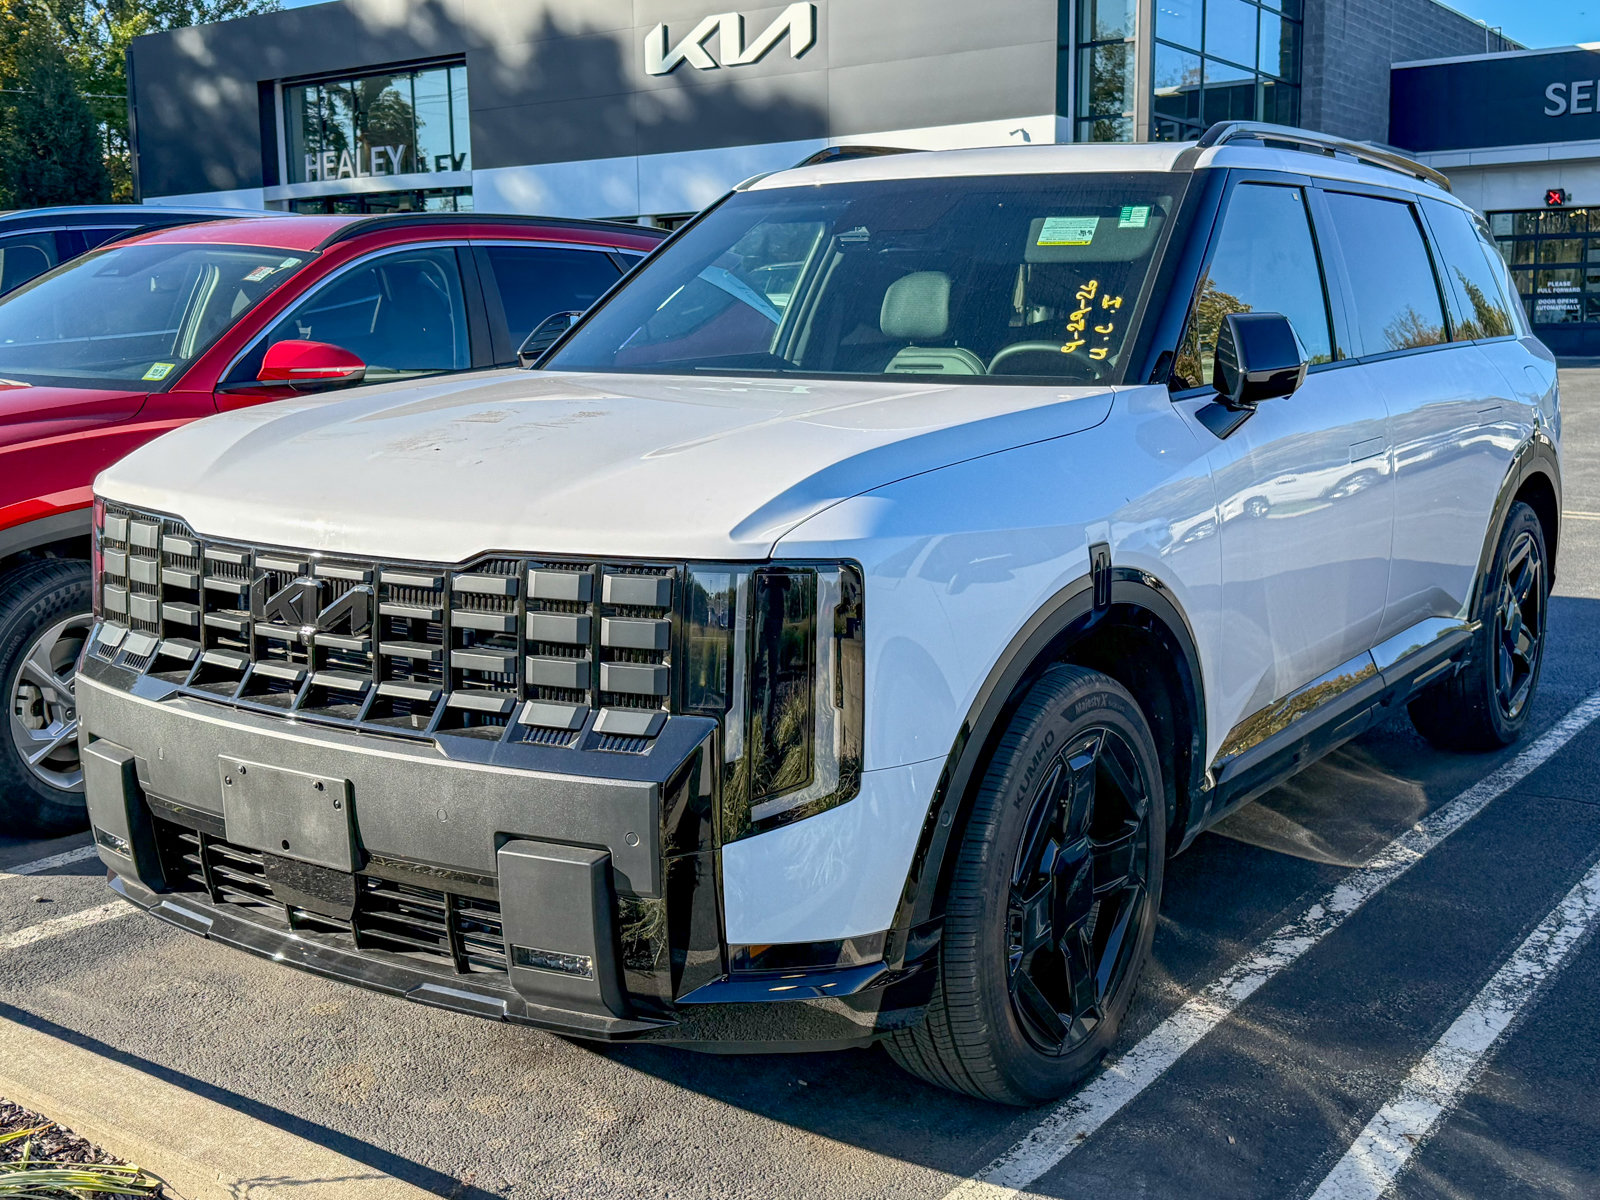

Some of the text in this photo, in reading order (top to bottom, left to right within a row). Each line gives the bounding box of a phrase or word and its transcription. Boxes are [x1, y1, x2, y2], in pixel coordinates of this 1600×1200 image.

[645, 1, 814, 76] KIA
[1544, 79, 1600, 117] SE
[304, 144, 407, 182] HEALEY
[1060, 279, 1098, 353] 9-29-26
[251, 571, 375, 637] KIA
[1012, 730, 1055, 810] KUMHO
